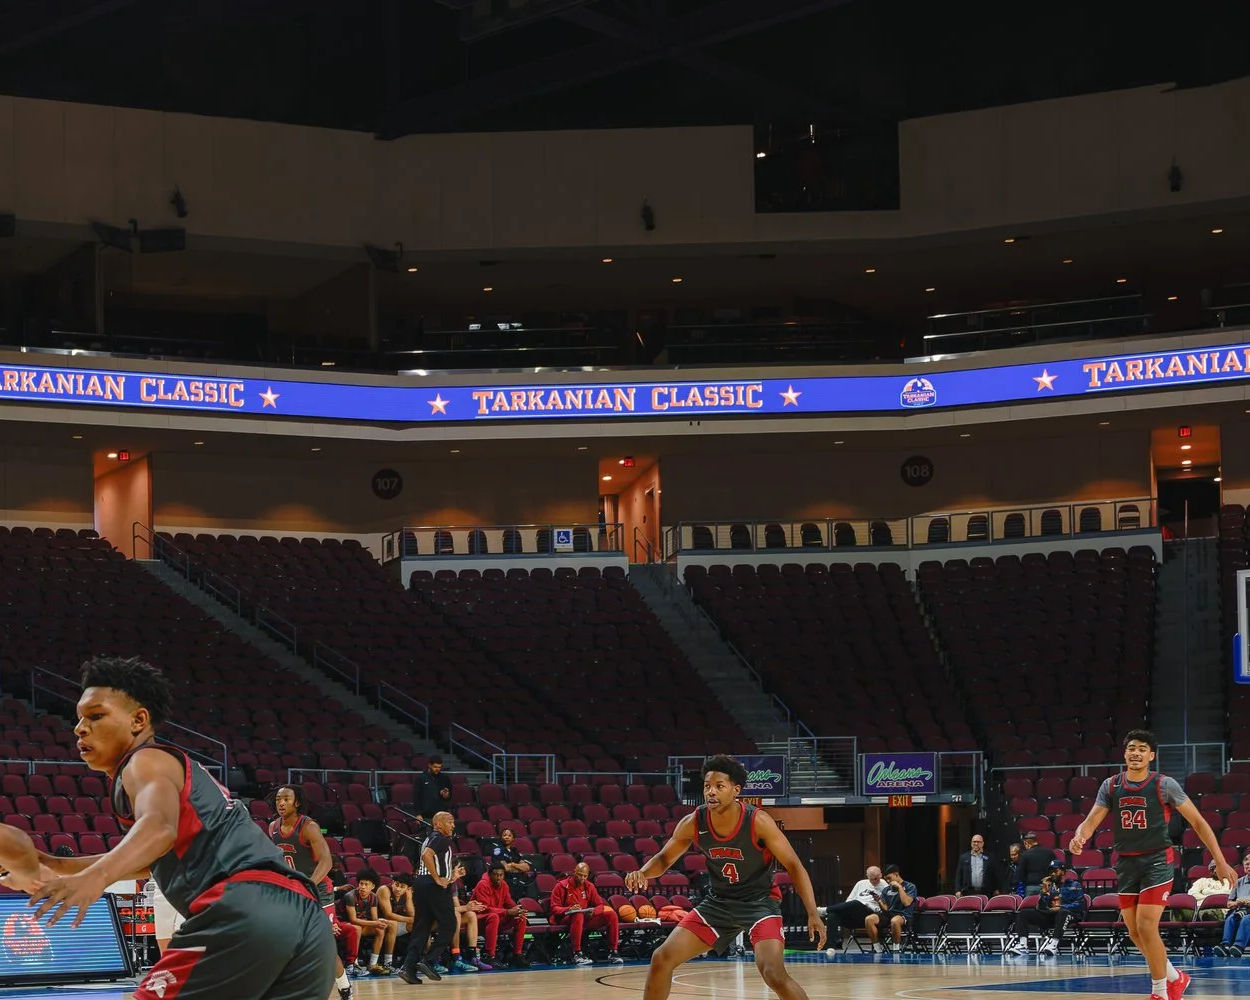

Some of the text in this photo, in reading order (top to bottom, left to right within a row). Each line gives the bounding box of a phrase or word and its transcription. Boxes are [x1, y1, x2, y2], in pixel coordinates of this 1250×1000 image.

[1083, 349, 1250, 387] TARKANIA
[140, 377, 244, 407] CLASSIC
[472, 384, 763, 415] TARKANIAN CLASSIC
[905, 464, 930, 478] 108
[375, 477, 398, 491] 107
[867, 761, 933, 785] Orleans
[876, 780, 924, 788] ARENA
[892, 795, 909, 807] EXIT
[1120, 809, 1147, 829] 24
[721, 862, 739, 884] 4
